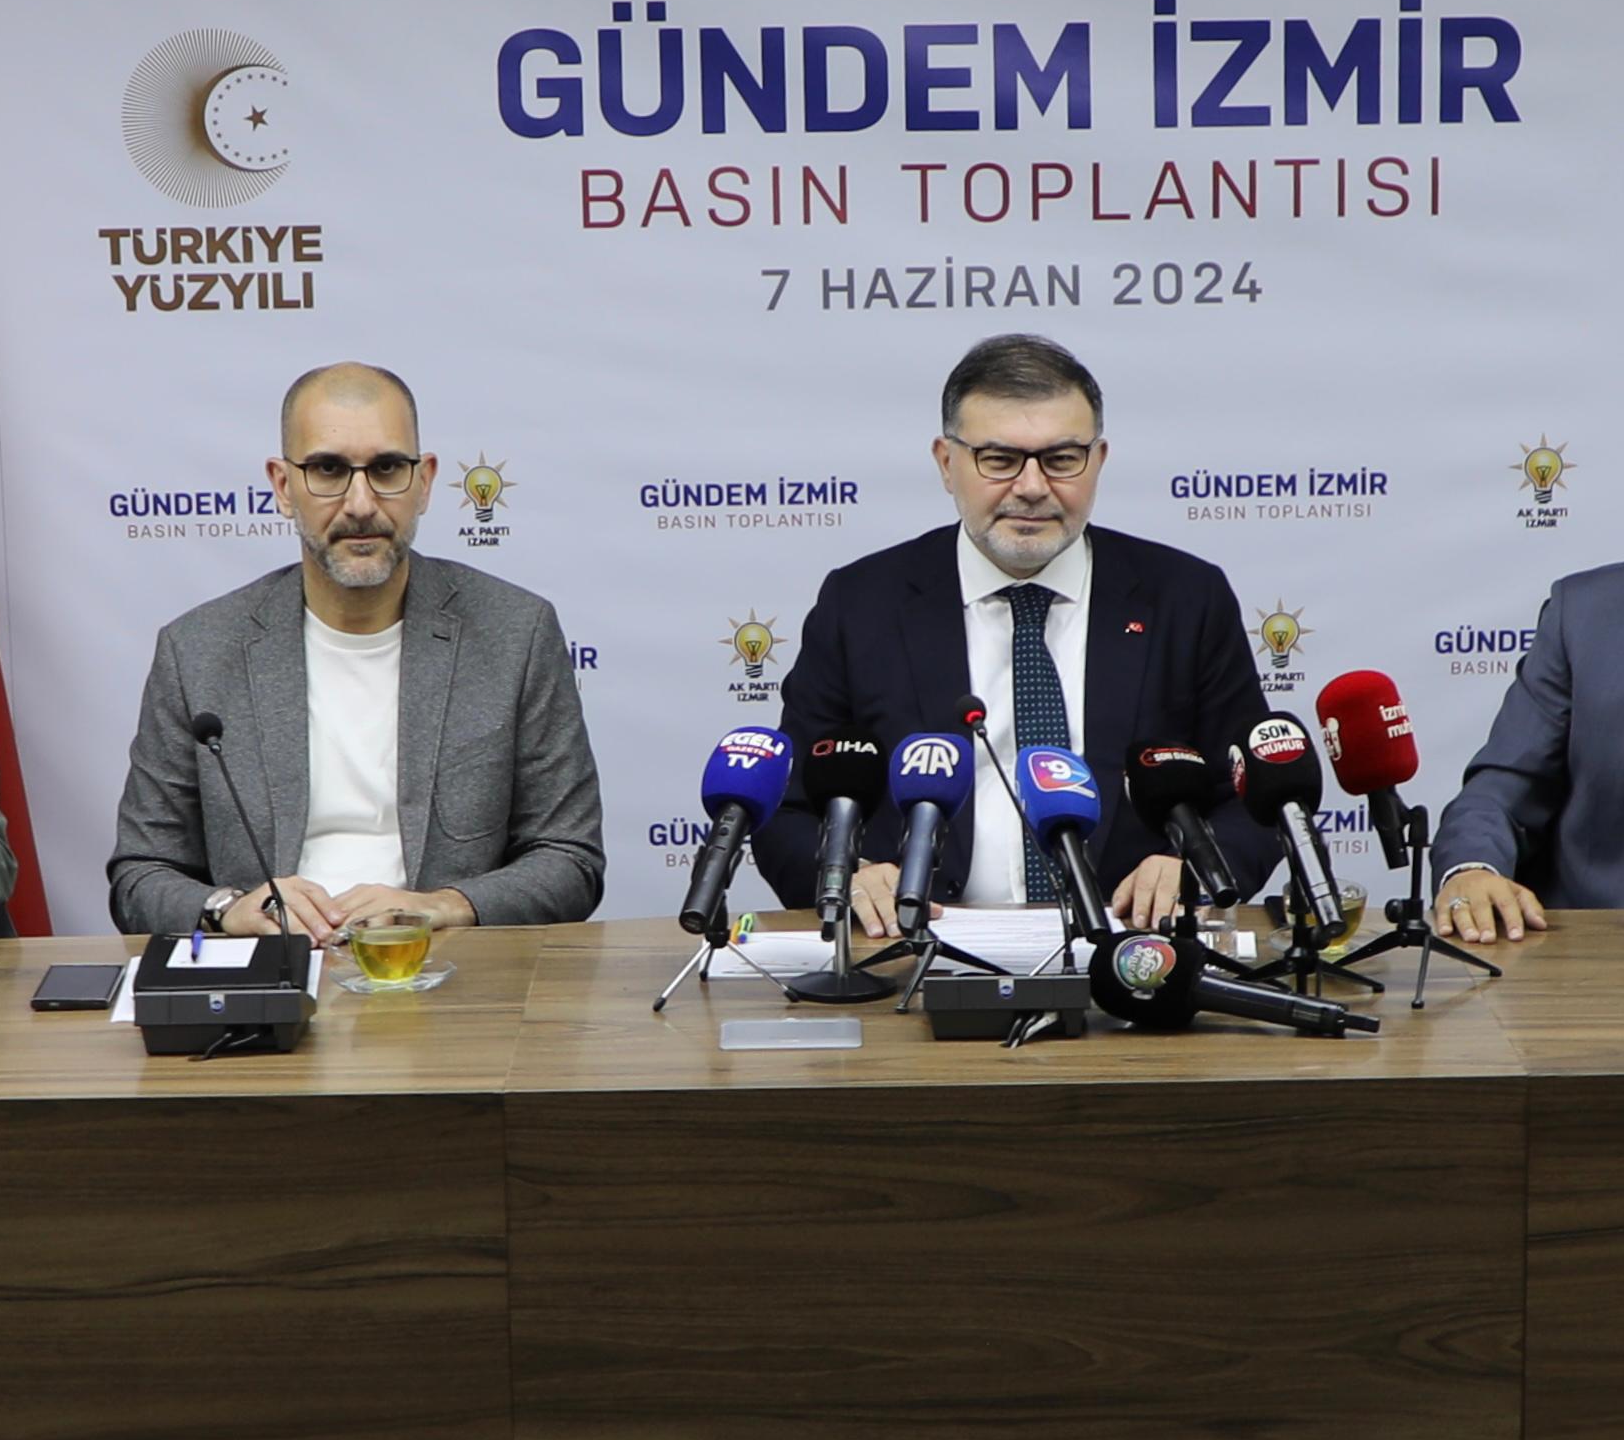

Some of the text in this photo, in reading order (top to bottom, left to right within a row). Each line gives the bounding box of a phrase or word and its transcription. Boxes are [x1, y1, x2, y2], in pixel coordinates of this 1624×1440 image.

[497, 1, 1091, 138] GÜNDEM
[581, 157, 1439, 229] BASIN TOPLANTISI
[112, 272, 314, 312] YÜZYILI
[761, 256, 1262, 310] 7 HAZİRAN 2024
[641, 476, 858, 507] GÜNDEM İZMİR
[1171, 467, 1388, 498] GÜNDEM İZMİR
[110, 486, 280, 517] GÜNDEM İZ
[1188, 504, 1371, 520] BASIN TOPLANTISI
[1517, 508, 1534, 518] AK
[128, 525, 186, 538] BASIN
[458, 526, 475, 536] AK
[658, 513, 842, 529] BASIN TOPLANTISI
[1435, 625, 1537, 653] GÜNDE
[1451, 661, 1508, 674] BASIN
[728, 683, 745, 692] AK
[1258, 724, 1291, 741] SON
[728, 753, 759, 769] TV
[900, 739, 958, 777] AA
[649, 818, 710, 846] GÜN
